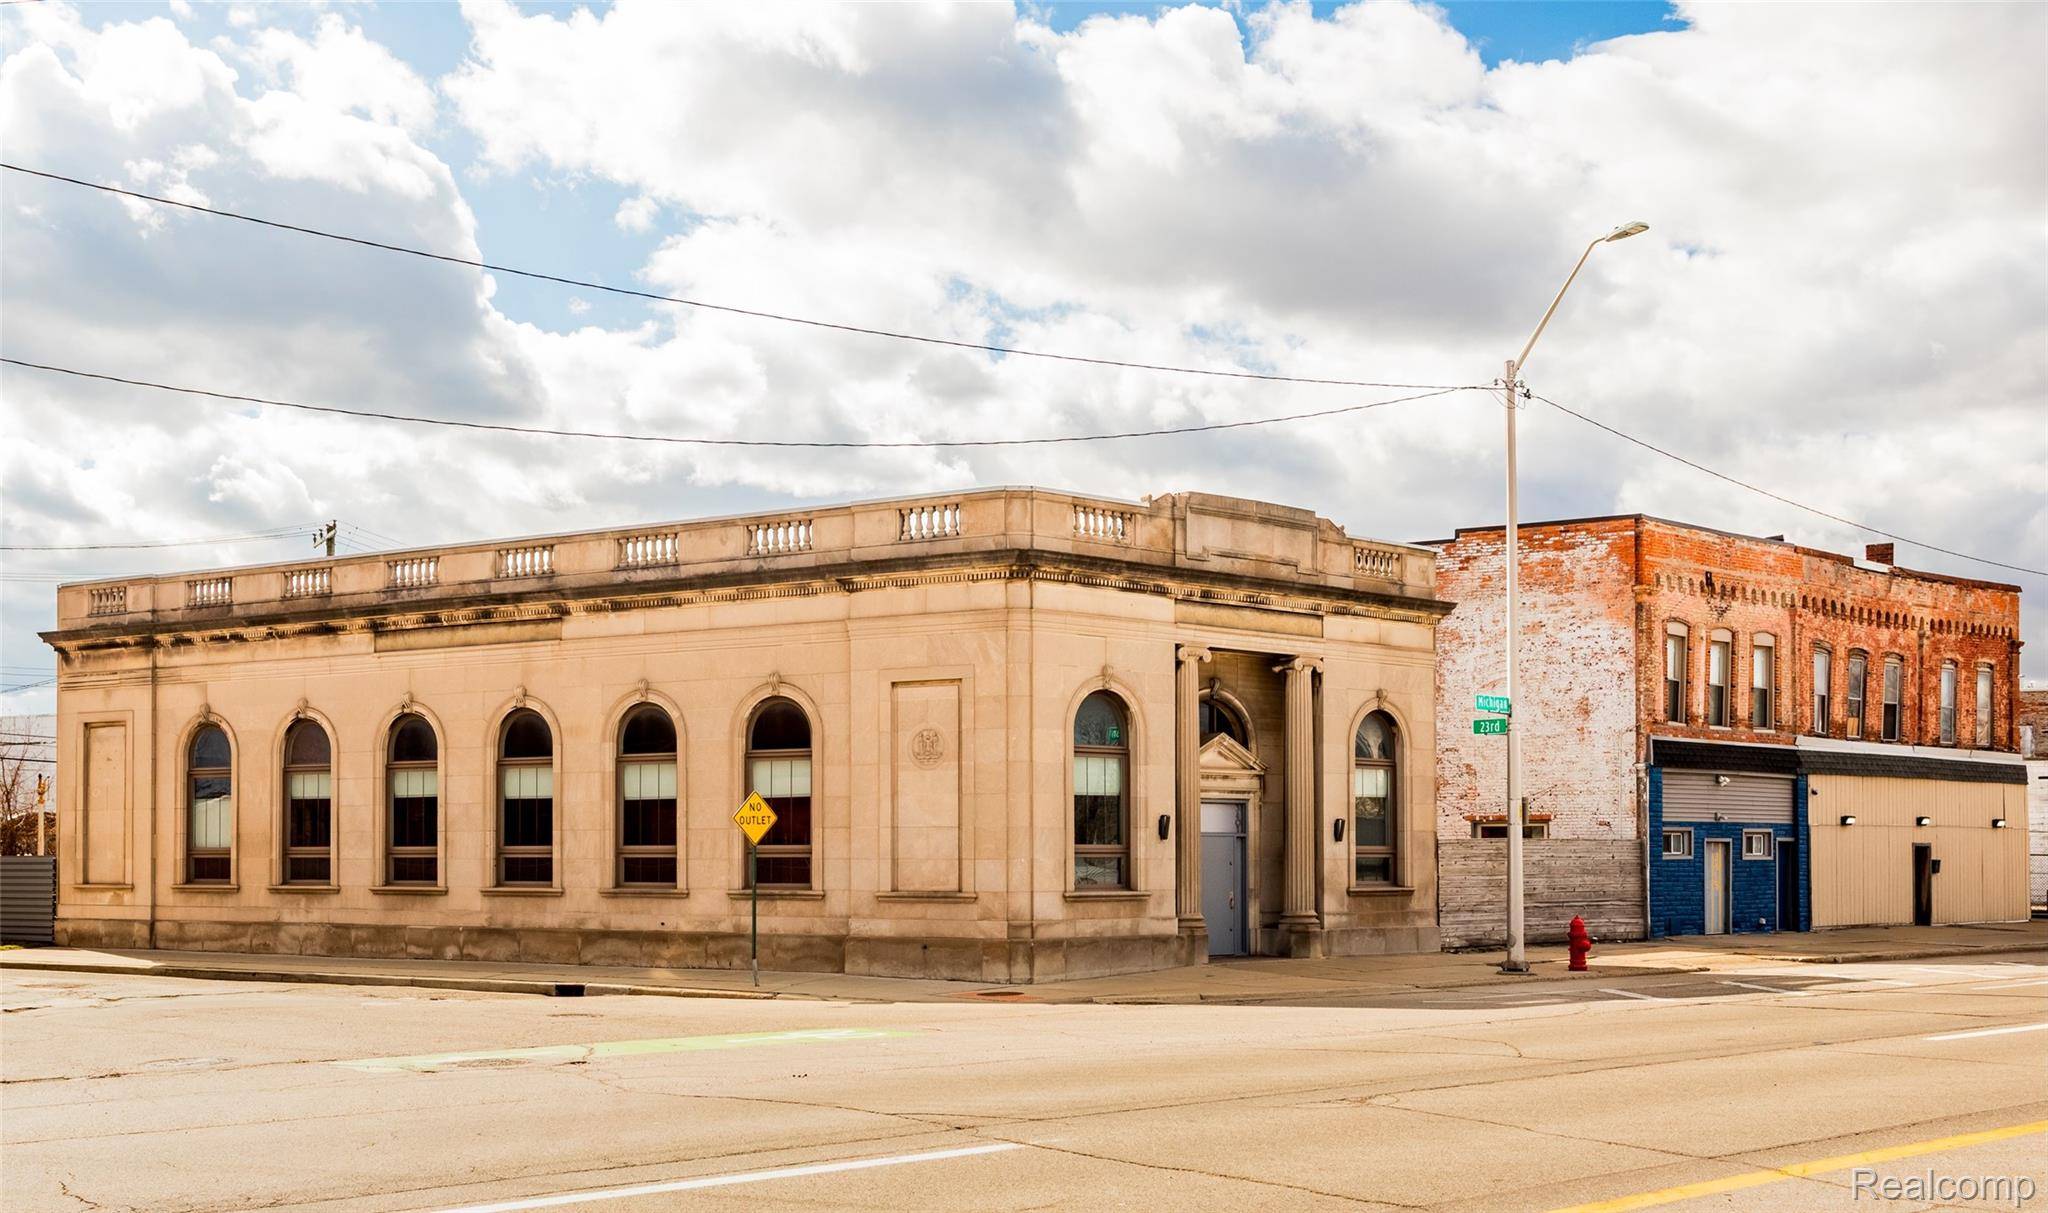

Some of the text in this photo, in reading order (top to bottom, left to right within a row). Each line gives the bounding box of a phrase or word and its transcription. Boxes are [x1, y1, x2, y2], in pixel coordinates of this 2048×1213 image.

[1478, 696, 1507, 712] Michigan
[1480, 721, 1500, 733] 23rd
[749, 802, 762, 812] NO
[739, 816, 771, 825] OUTLET
